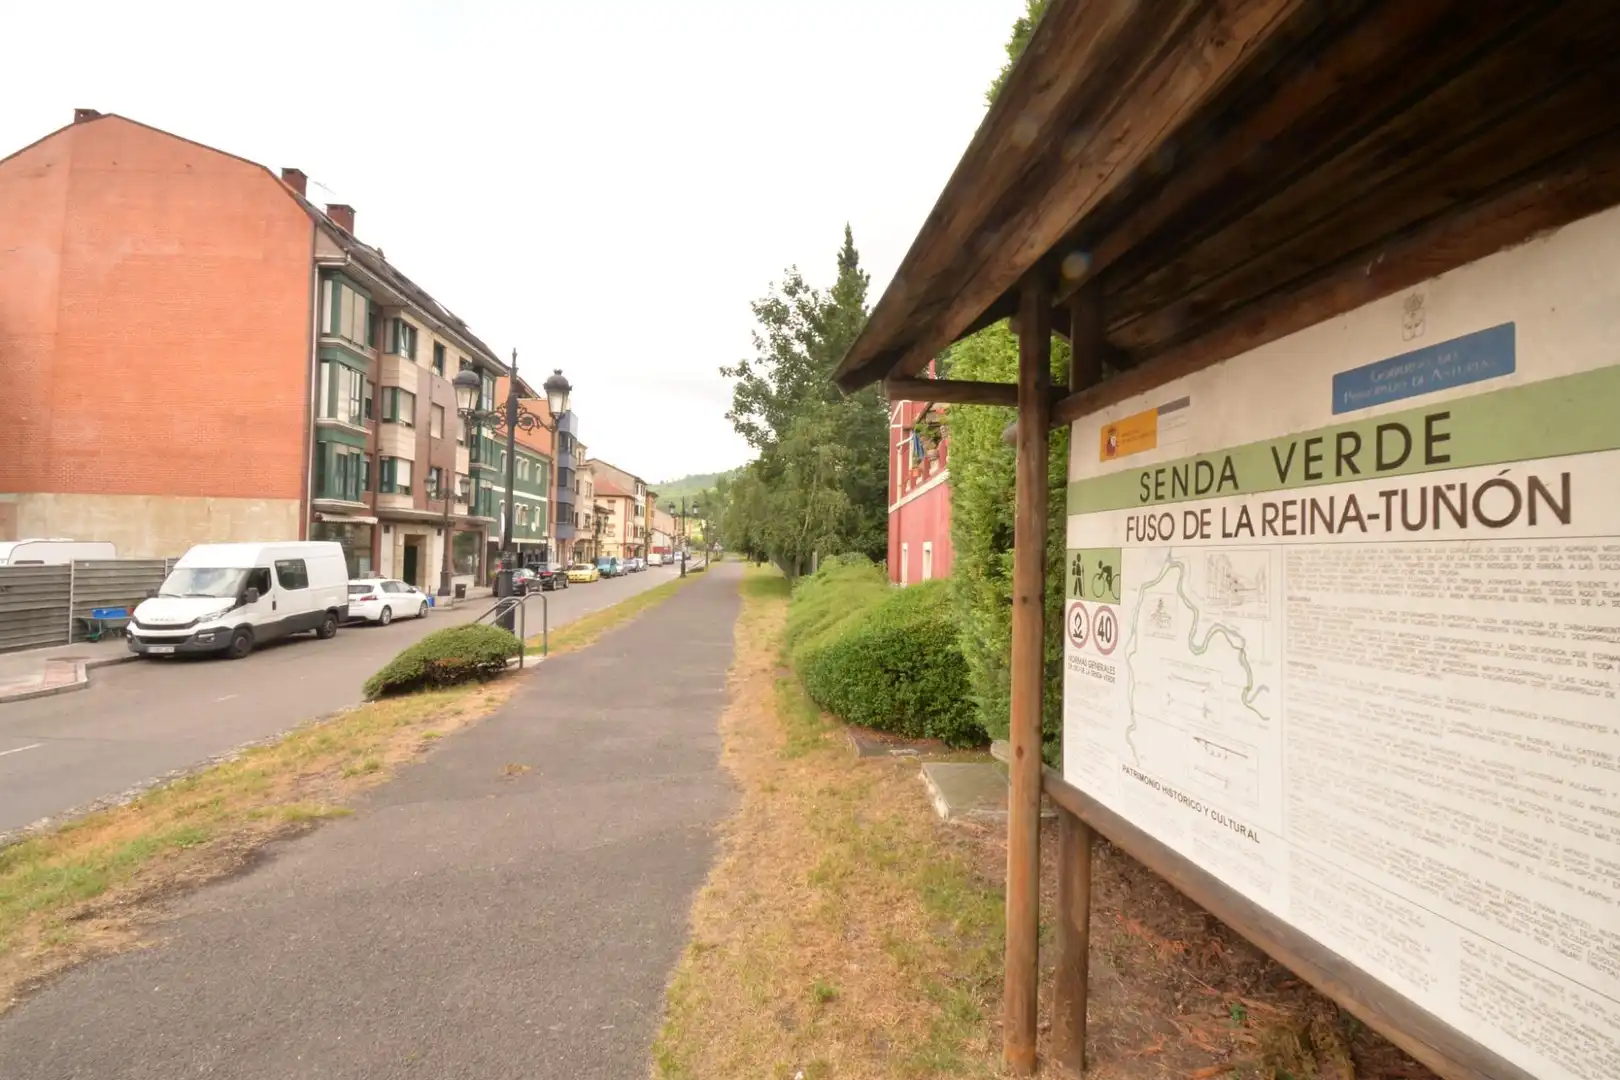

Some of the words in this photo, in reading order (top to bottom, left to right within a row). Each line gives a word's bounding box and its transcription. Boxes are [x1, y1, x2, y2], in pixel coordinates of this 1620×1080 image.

[1139, 455, 1240, 503] SENDA
[1271, 410, 1451, 485] VERDE
[1126, 511, 1176, 543] FUSO
[1183, 508, 1212, 540] DE
[1221, 504, 1256, 539] LA
[1261, 468, 1572, 537] REINA-TUÑÓN
[1097, 614, 1113, 644] 40
[1121, 763, 1161, 791] PATRIMONIO
[1202, 805, 1209, 817] Y
[1210, 809, 1261, 844] CULTURAL
